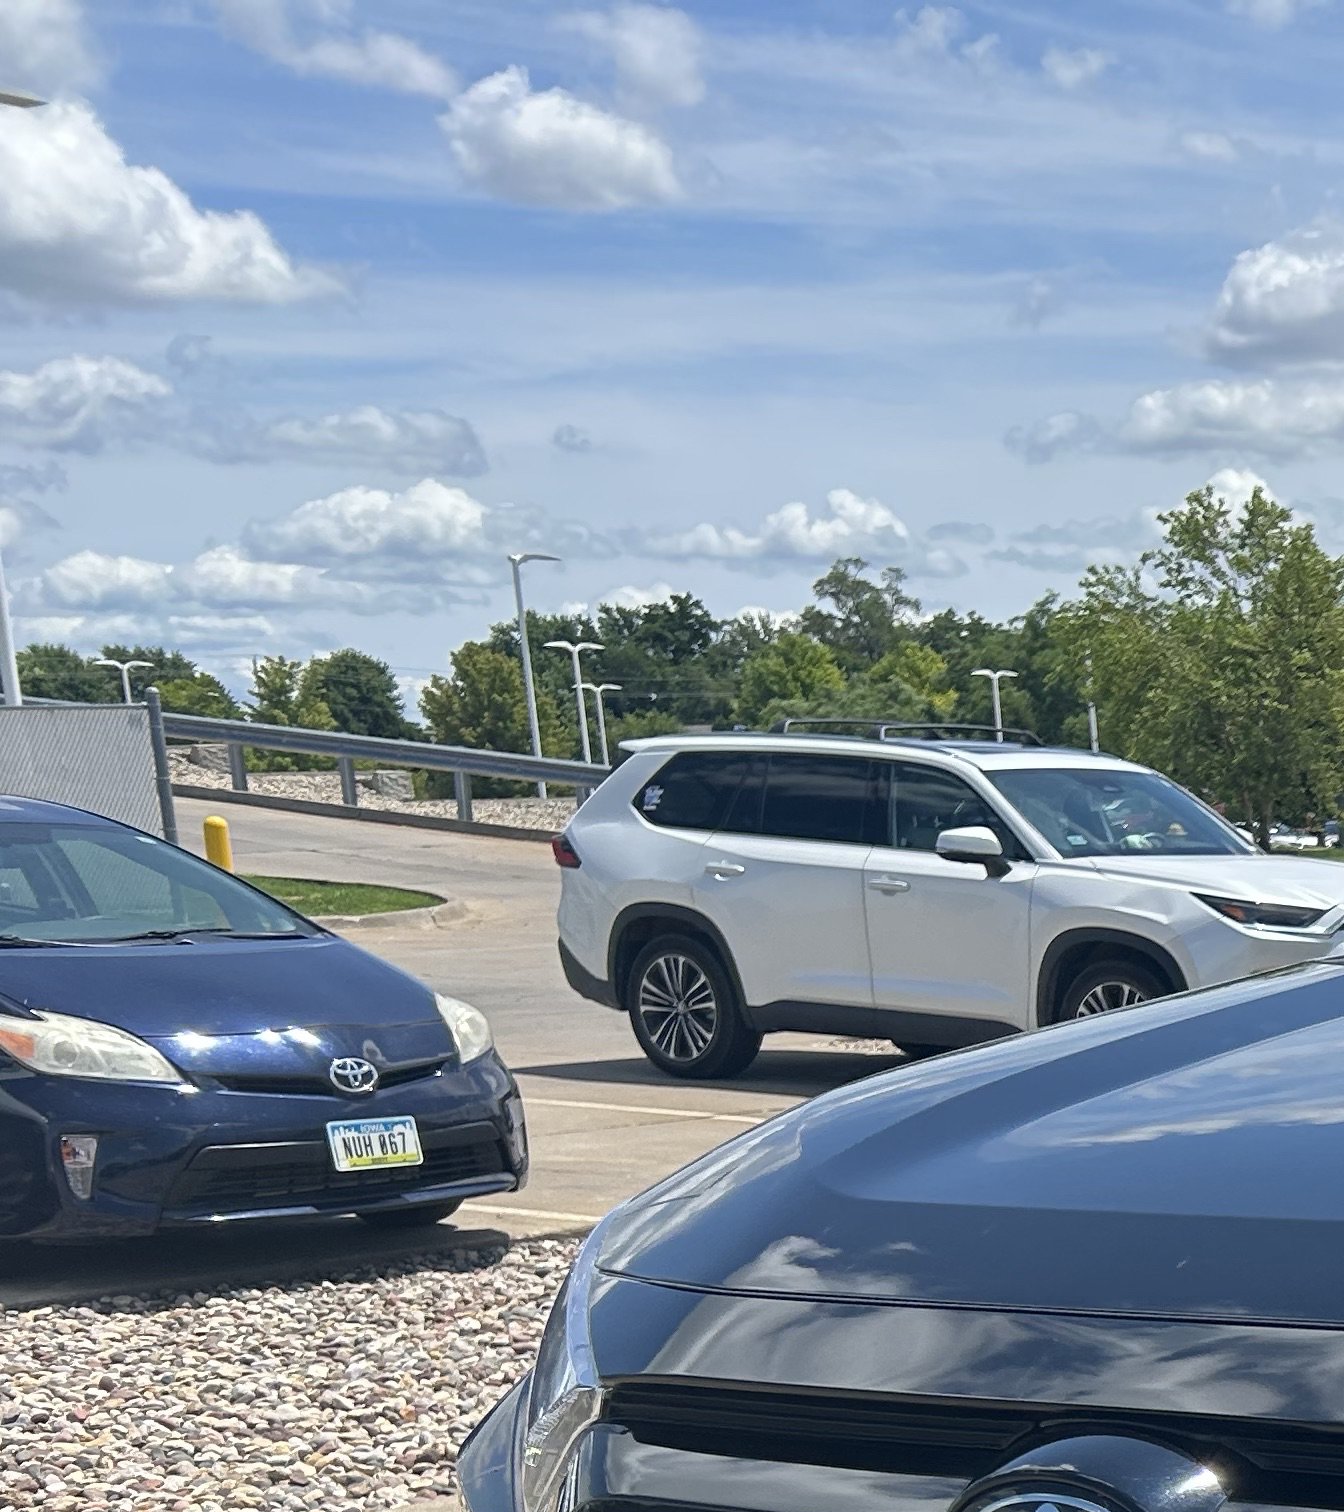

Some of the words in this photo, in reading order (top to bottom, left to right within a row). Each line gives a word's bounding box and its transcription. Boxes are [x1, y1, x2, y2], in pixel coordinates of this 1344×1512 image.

[360, 1122, 386, 1134] IOWA
[341, 1133, 375, 1159] NUH
[378, 1131, 407, 1156] 067
